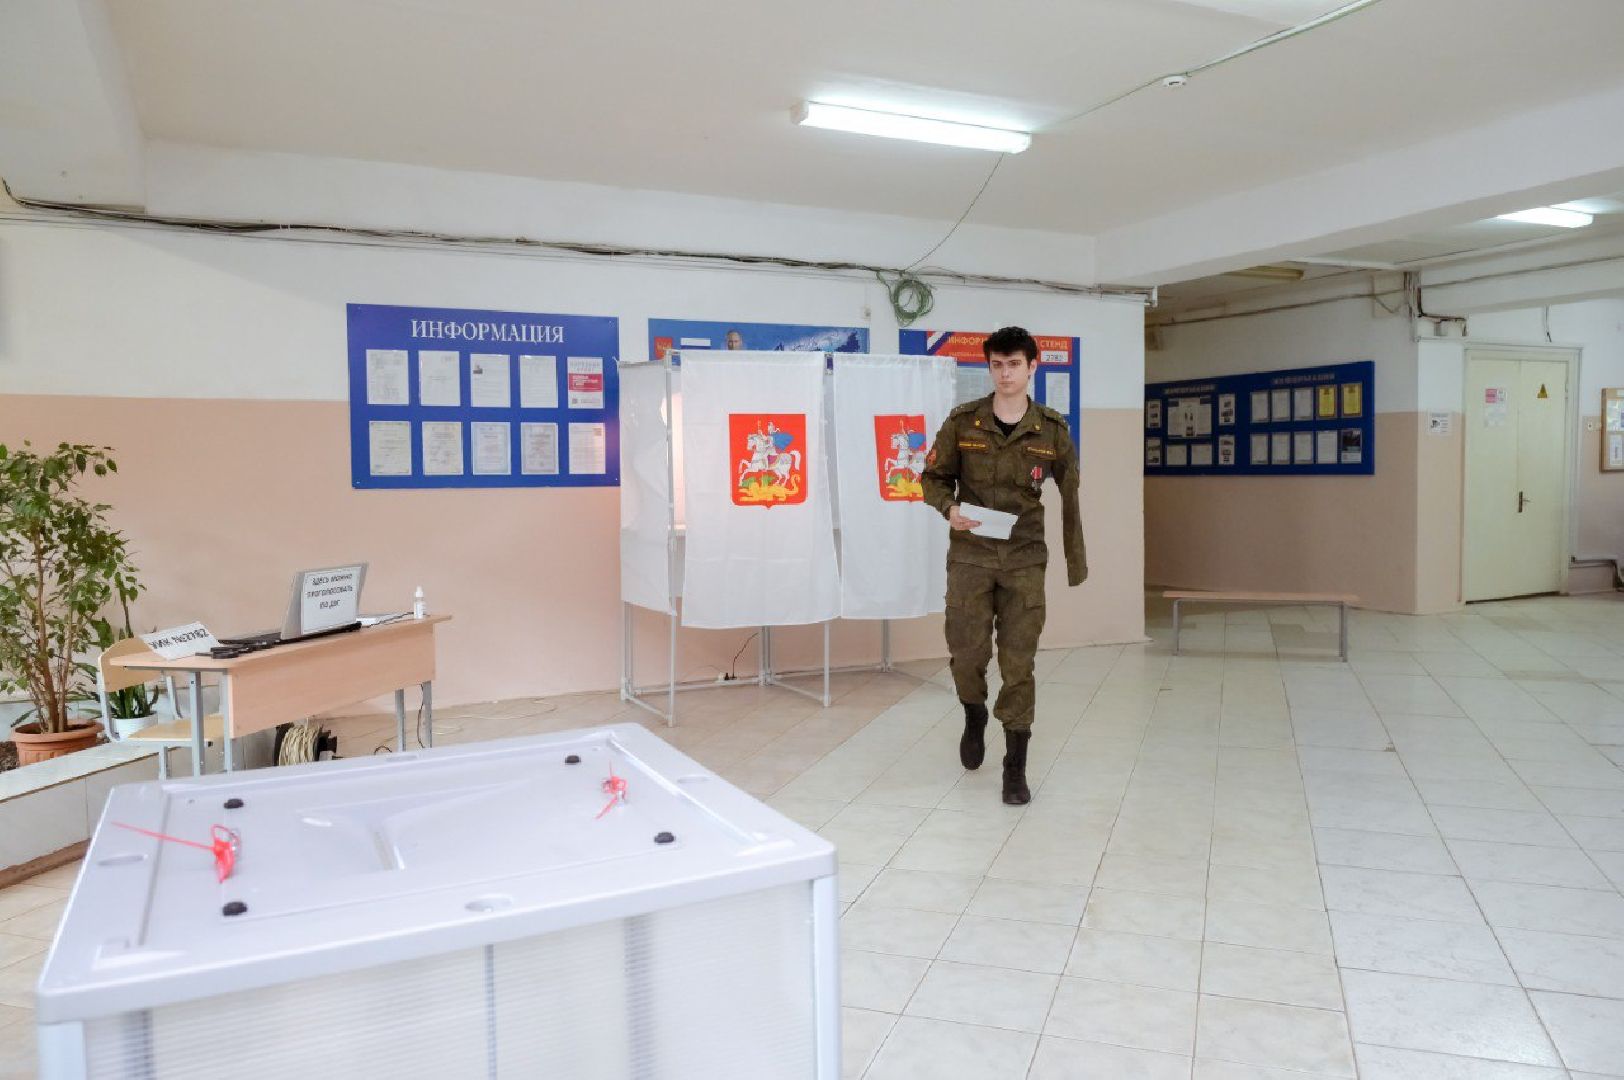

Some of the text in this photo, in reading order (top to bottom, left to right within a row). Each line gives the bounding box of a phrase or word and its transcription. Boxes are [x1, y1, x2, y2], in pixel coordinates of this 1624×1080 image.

[411, 319, 565, 345] ИНФОРМАЦИЯ
[1040, 340, 1068, 350] СТЕНД
[312, 573, 353, 586] ЗДЕСЬ МОЖНО
